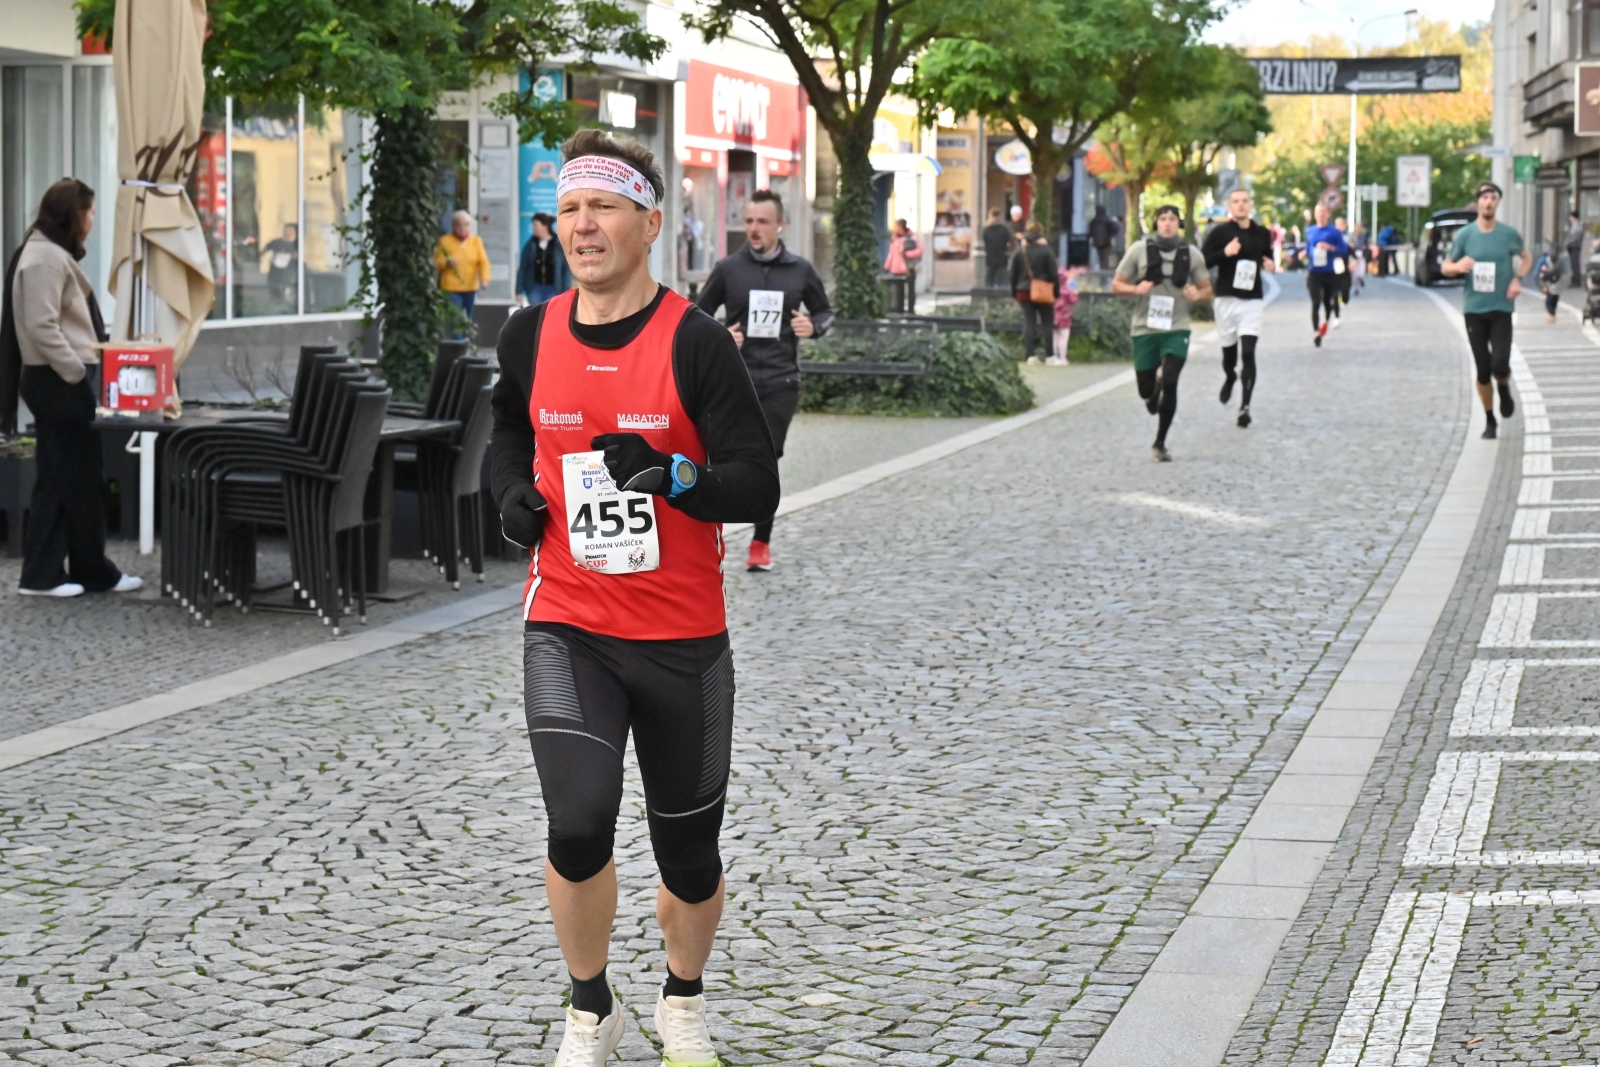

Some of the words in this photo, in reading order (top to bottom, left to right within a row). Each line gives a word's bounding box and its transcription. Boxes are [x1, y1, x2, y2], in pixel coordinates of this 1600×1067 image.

[1250, 60, 1338, 92] RZLINU?
[594, 164, 614, 172] vrchu
[615, 169, 630, 181] 2025
[751, 310, 780, 324] 177
[617, 414, 669, 423] MARATON
[570, 497, 653, 539] 455
[585, 542, 613, 551] ROMAN
[614, 539, 644, 548] VAŠÍČEK
[587, 560, 608, 568] CUP
